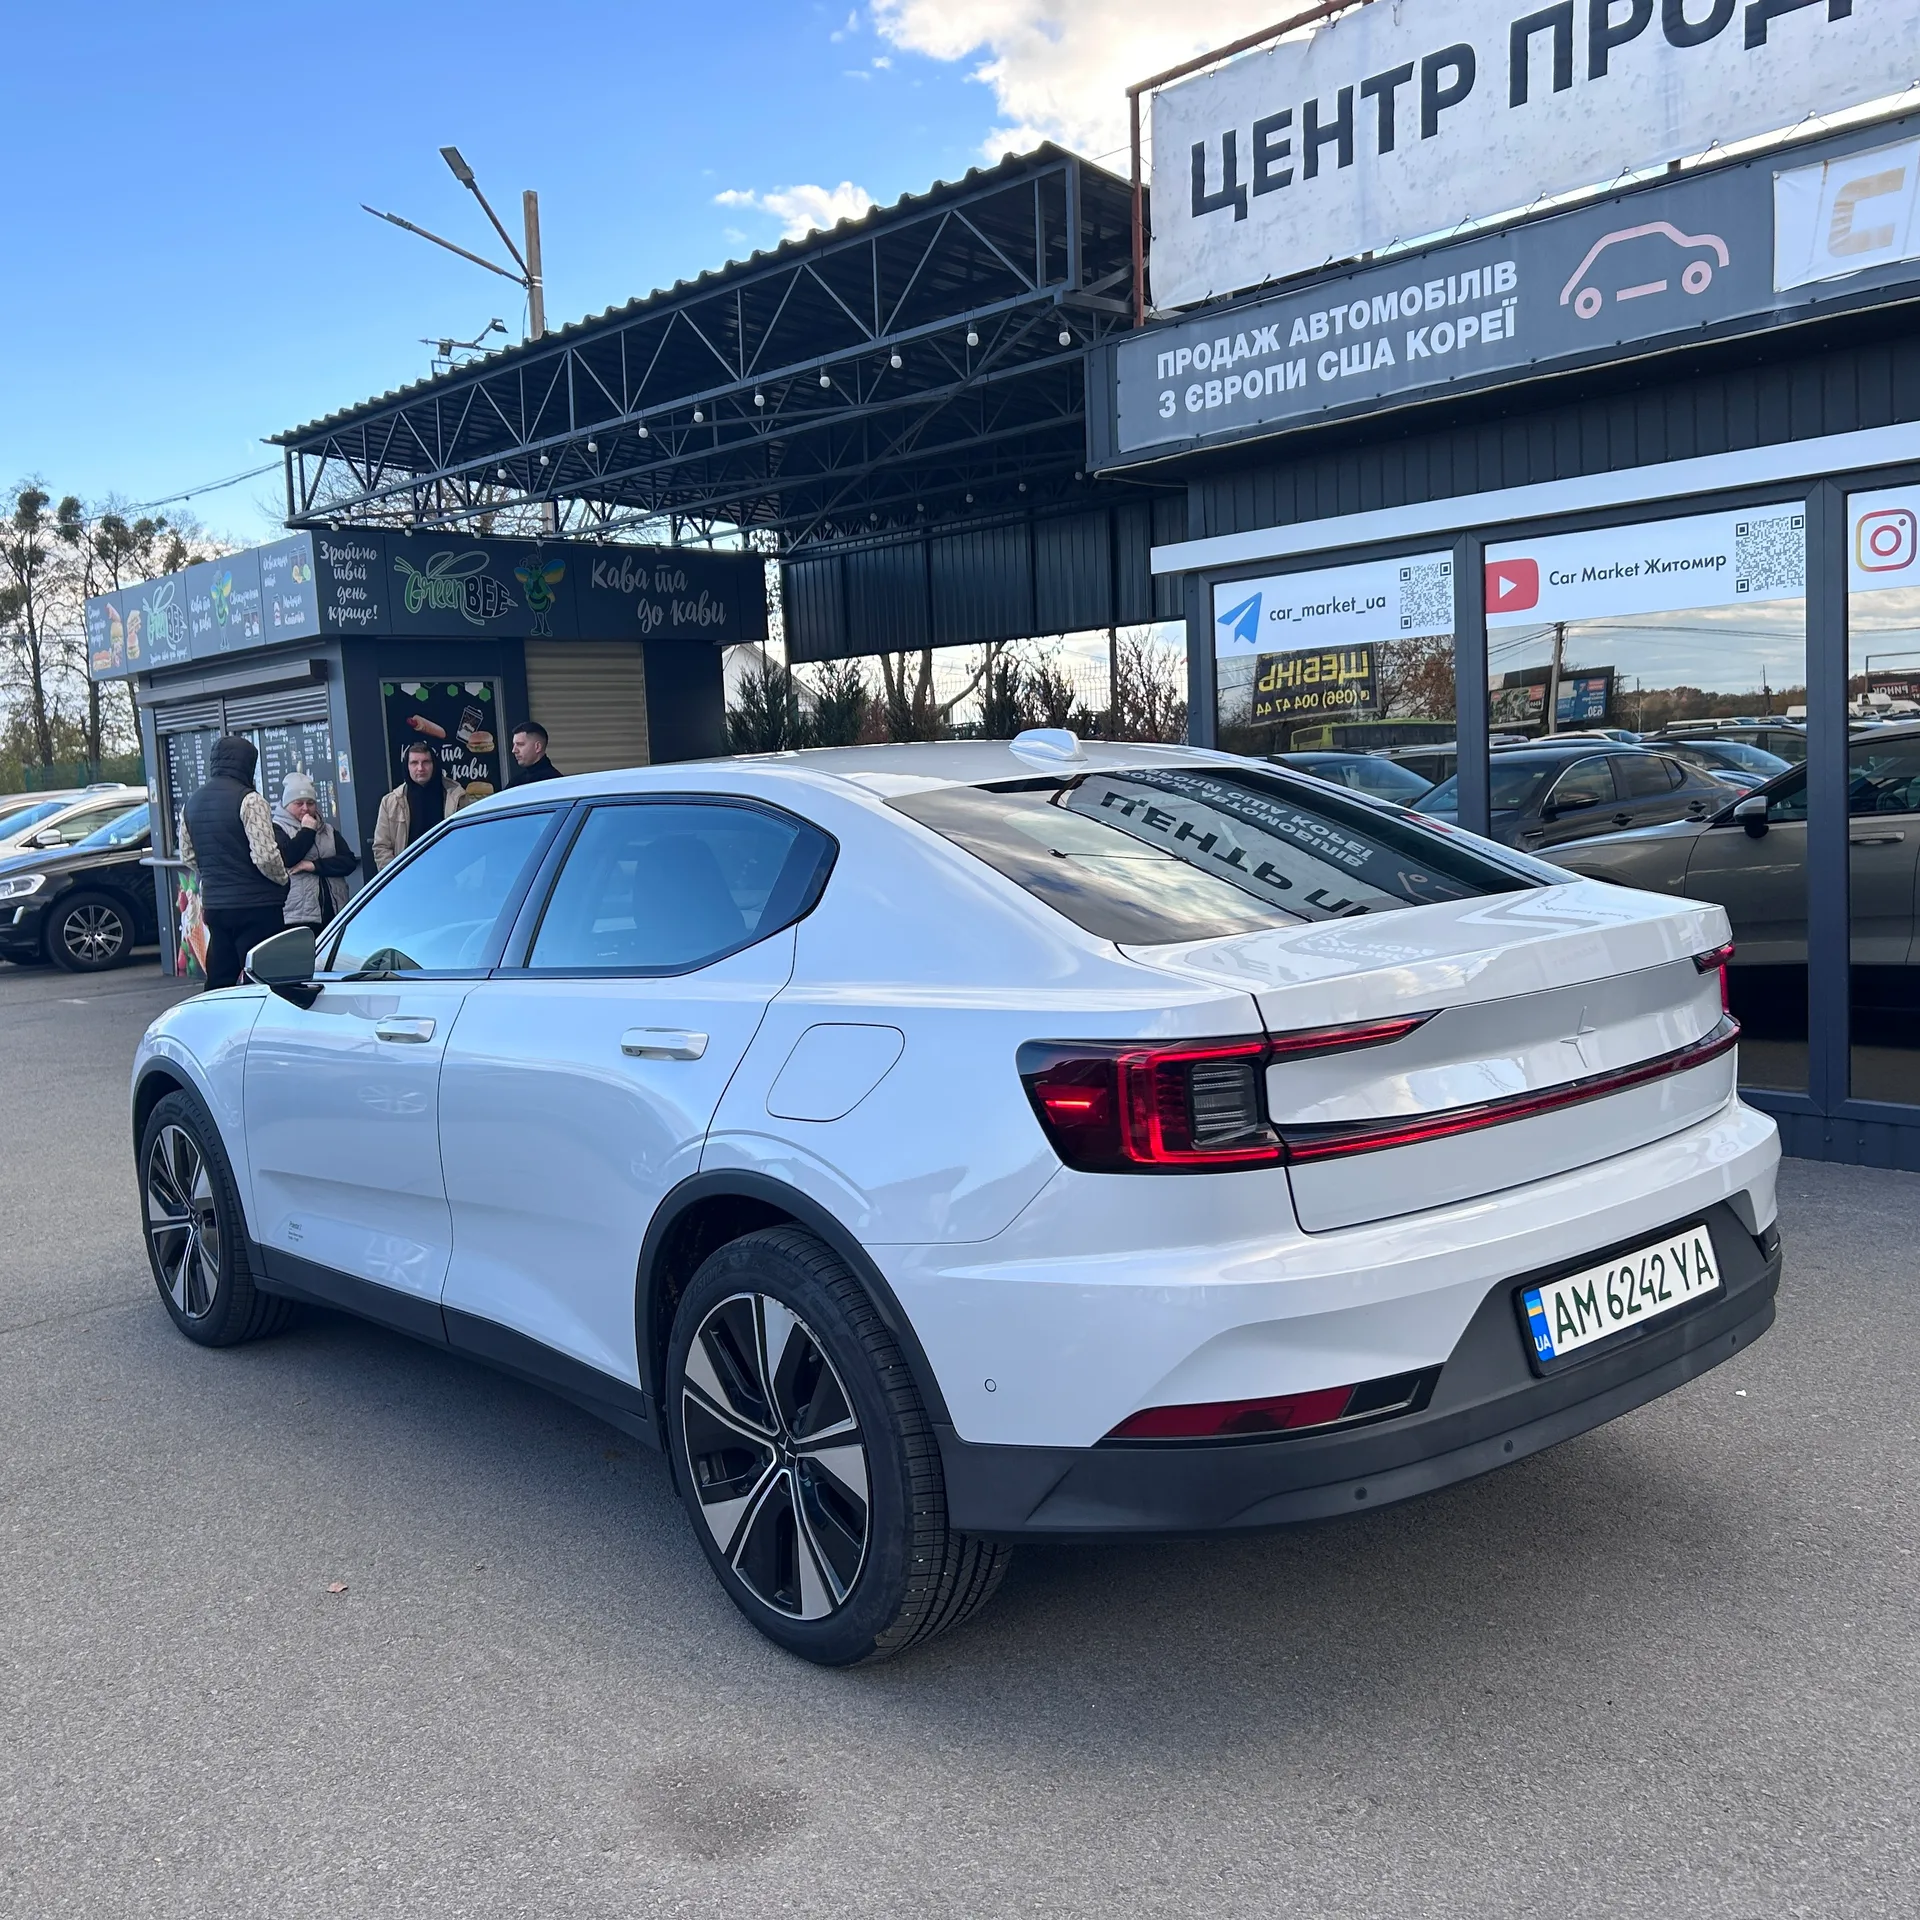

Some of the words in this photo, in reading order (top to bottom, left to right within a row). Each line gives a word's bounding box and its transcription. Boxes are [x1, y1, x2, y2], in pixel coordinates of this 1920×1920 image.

[1190, 42, 1477, 222] ЦЕНТР
[1157, 323, 1280, 380] ПРОДАЖ
[1288, 260, 1518, 347] АВТОМОБІЛІВ
[1159, 390, 1176, 418] З
[1184, 358, 1306, 413] ЄВРОПИ
[1317, 337, 1396, 382] США
[1406, 297, 1518, 362] КОРЕЇ
[319, 540, 378, 567] Зробимо
[333, 561, 367, 581] твій
[591, 555, 650, 593] Кава
[655, 564, 688, 593] та
[1549, 570, 1577, 586] Car
[1581, 561, 1640, 583] Market
[1643, 553, 1727, 576] Житомир
[336, 585, 367, 605] день
[327, 604, 378, 627] краще!
[637, 597, 664, 634] до
[670, 589, 726, 627] кави
[1269, 596, 1386, 622] car_market_ua
[441, 743, 464, 762] та
[451, 757, 489, 780] кави
[1555, 1279, 1603, 1344] AM
[1606, 1254, 1672, 1320] 6242
[1670, 1238, 1714, 1291] YA
[1534, 1333, 1552, 1352] UA
